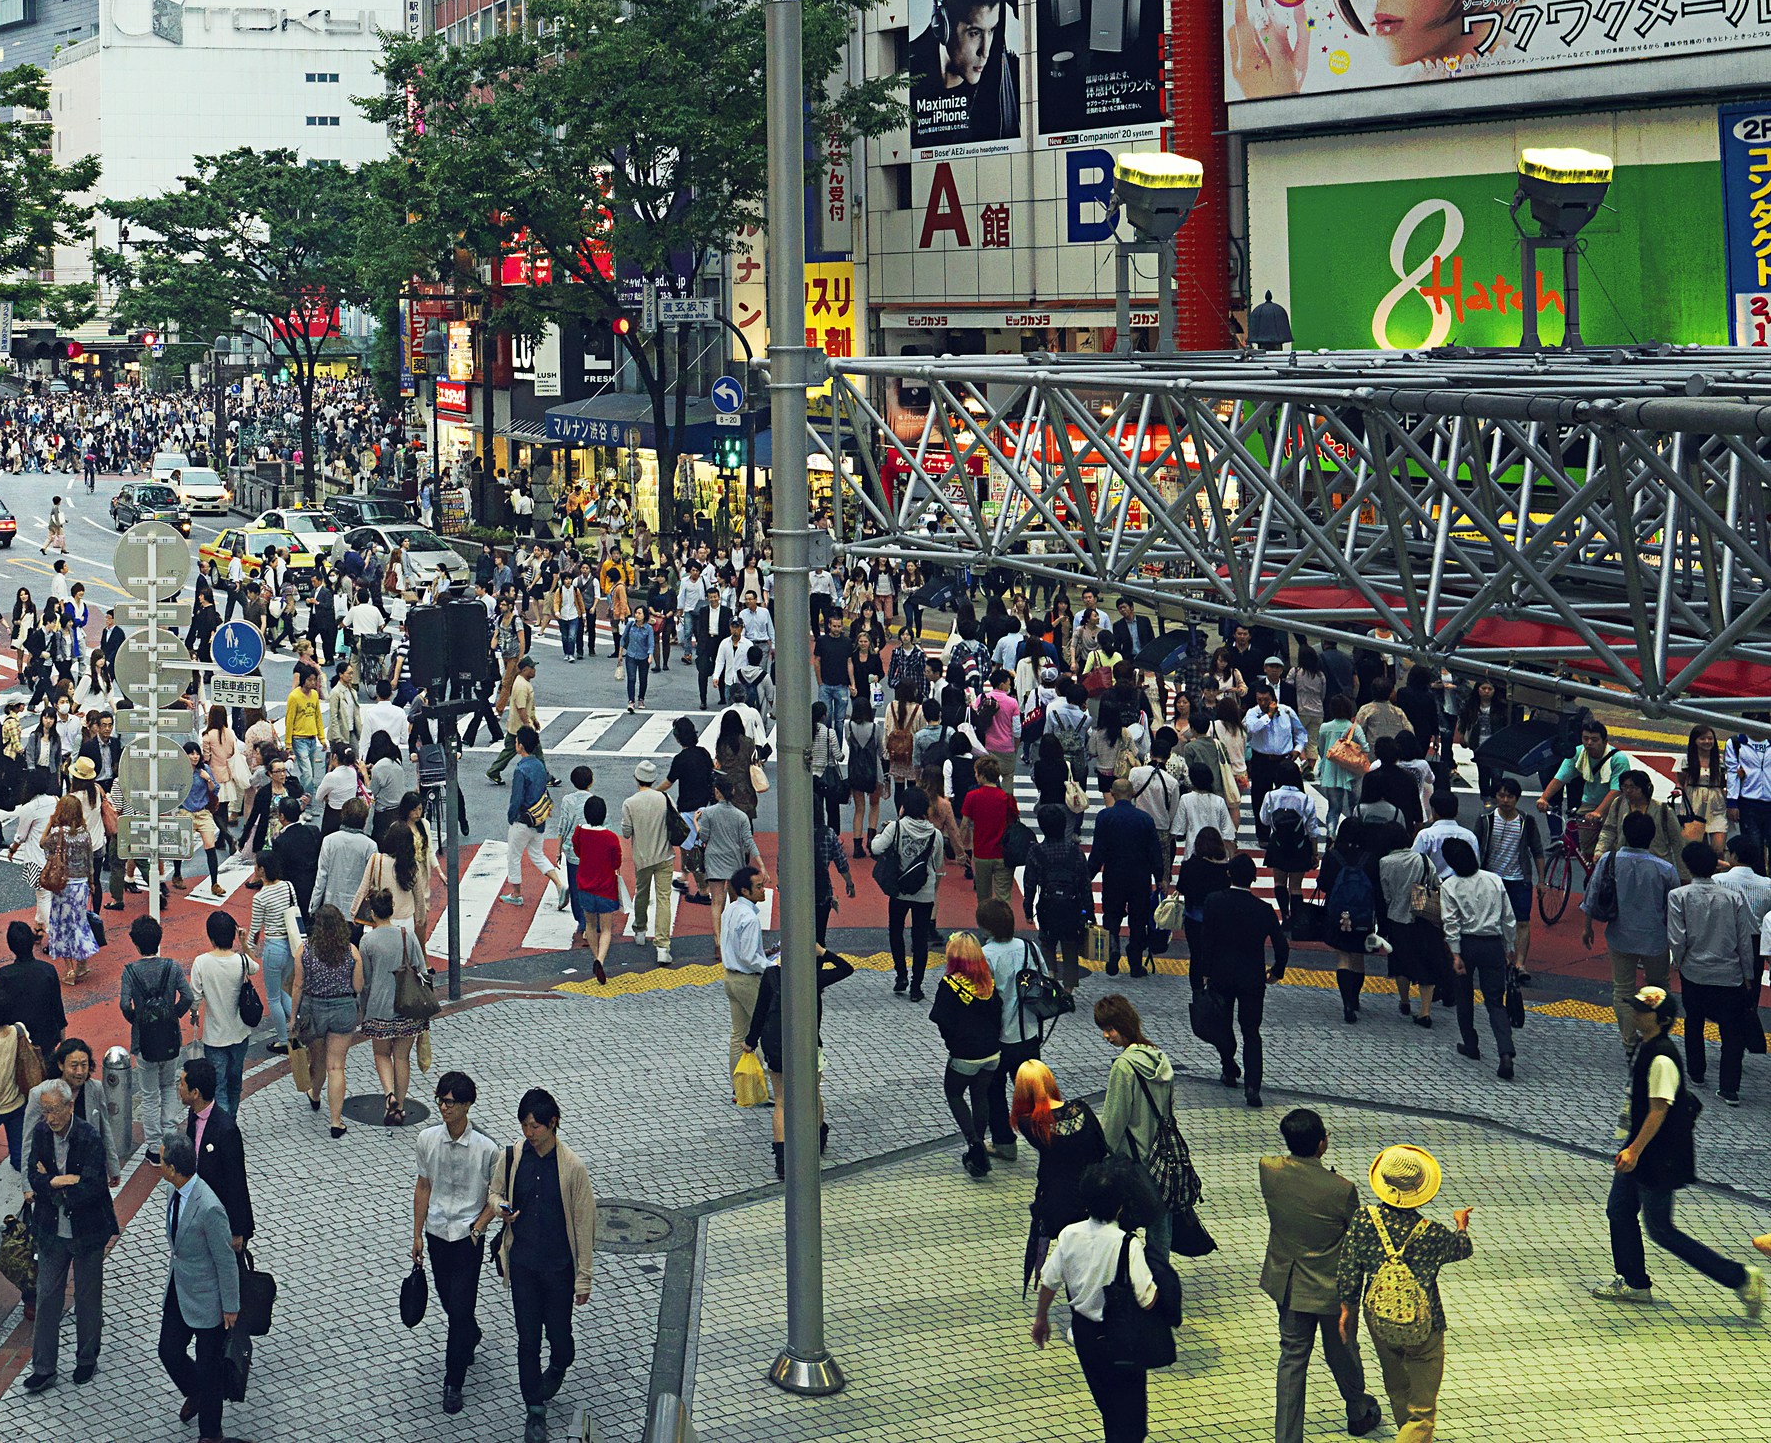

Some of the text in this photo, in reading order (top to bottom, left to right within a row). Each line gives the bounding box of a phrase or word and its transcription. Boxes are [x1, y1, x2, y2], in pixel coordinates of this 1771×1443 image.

[1085, 78, 1156, 99] 体感PCサウンド。
[916, 95, 967, 113] Maximize
[917, 109, 970, 127] your iPhone.
[1048, 137, 1062, 145] New
[1122, 129, 1132, 139] 20
[1132, 129, 1155, 139] system
[921, 151, 933, 159] New
[979, 145, 1009, 154] headphones
[1066, 148, 1121, 244] B
[1371, 198, 1465, 351] 8
[805, 276, 851, 317] スリ
[662, 301, 709, 313] 道玄坂下
[908, 314, 949, 327] ビックカメラ
[1005, 313, 1051, 327] ビックカメラ
[413, 358, 426, 372] 薬
[584, 375, 616, 383] FRESH
[553, 418, 608, 441] マルナン渋谷
[213, 678, 261, 693] 自転車通行可
[213, 693, 261, 707] ここまで
